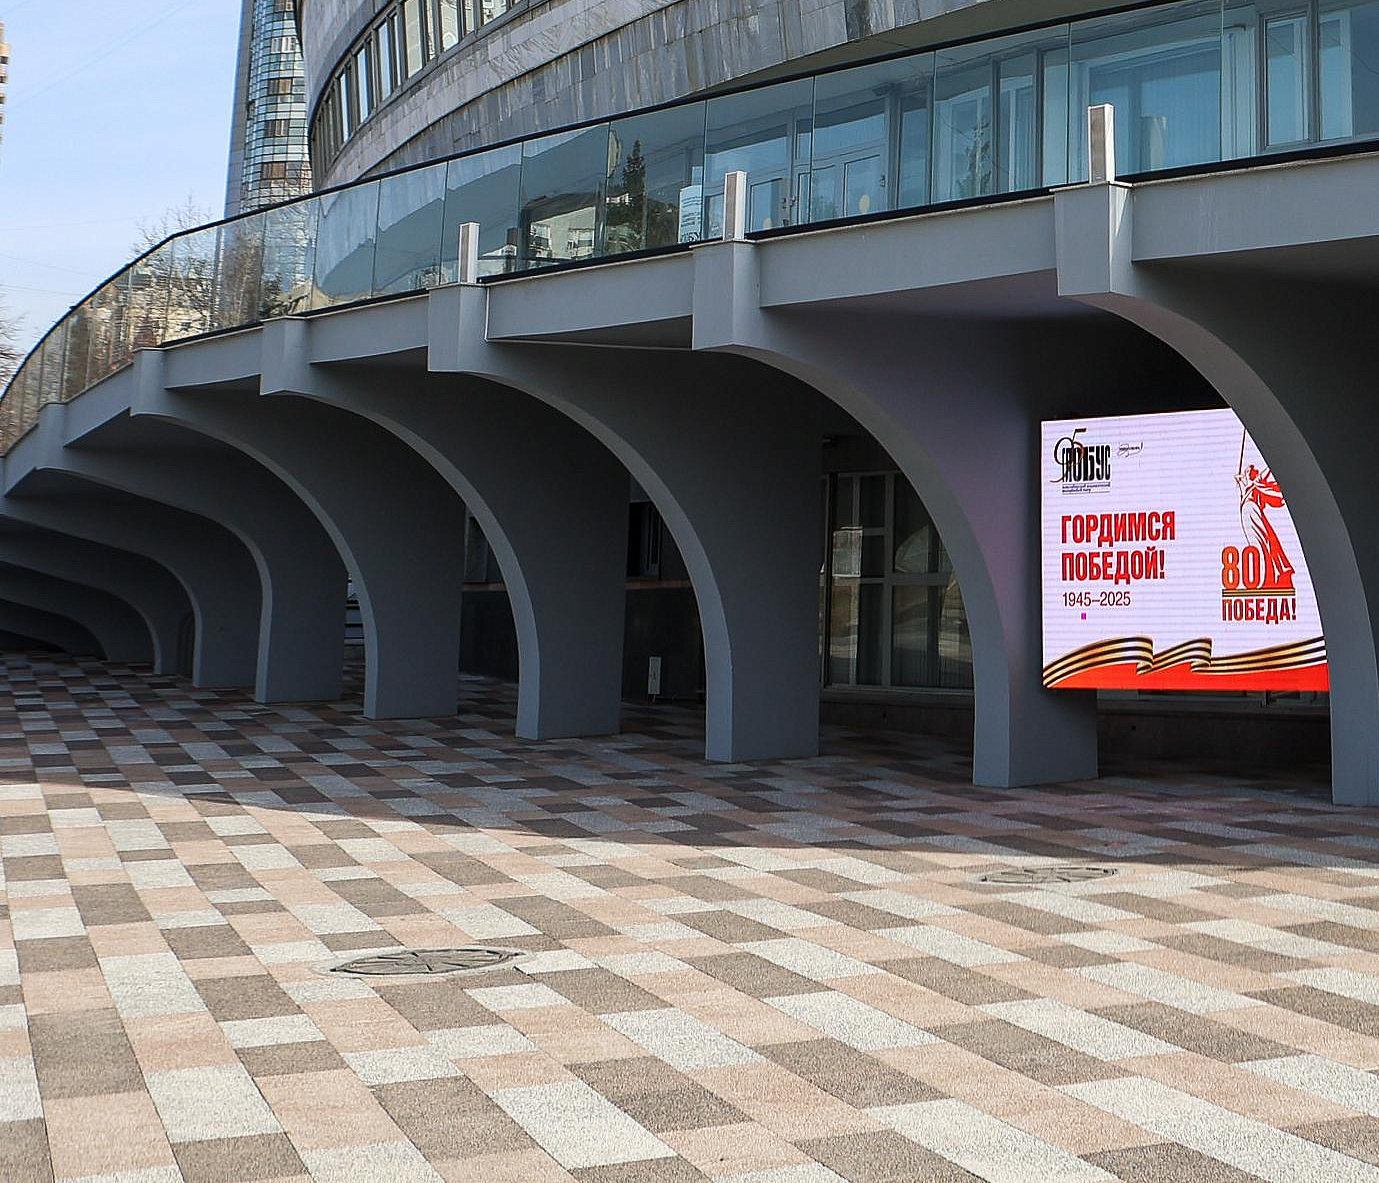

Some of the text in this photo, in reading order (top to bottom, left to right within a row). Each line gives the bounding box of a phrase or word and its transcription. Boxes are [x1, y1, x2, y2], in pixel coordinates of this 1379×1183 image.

[1061, 511, 1176, 548] ГОРДИМСЯ
[1061, 546, 1166, 585] ПОБЕДОЙ!
[1221, 545, 1259, 590] 80
[1221, 597, 1297, 625] ПОБЕДА!
